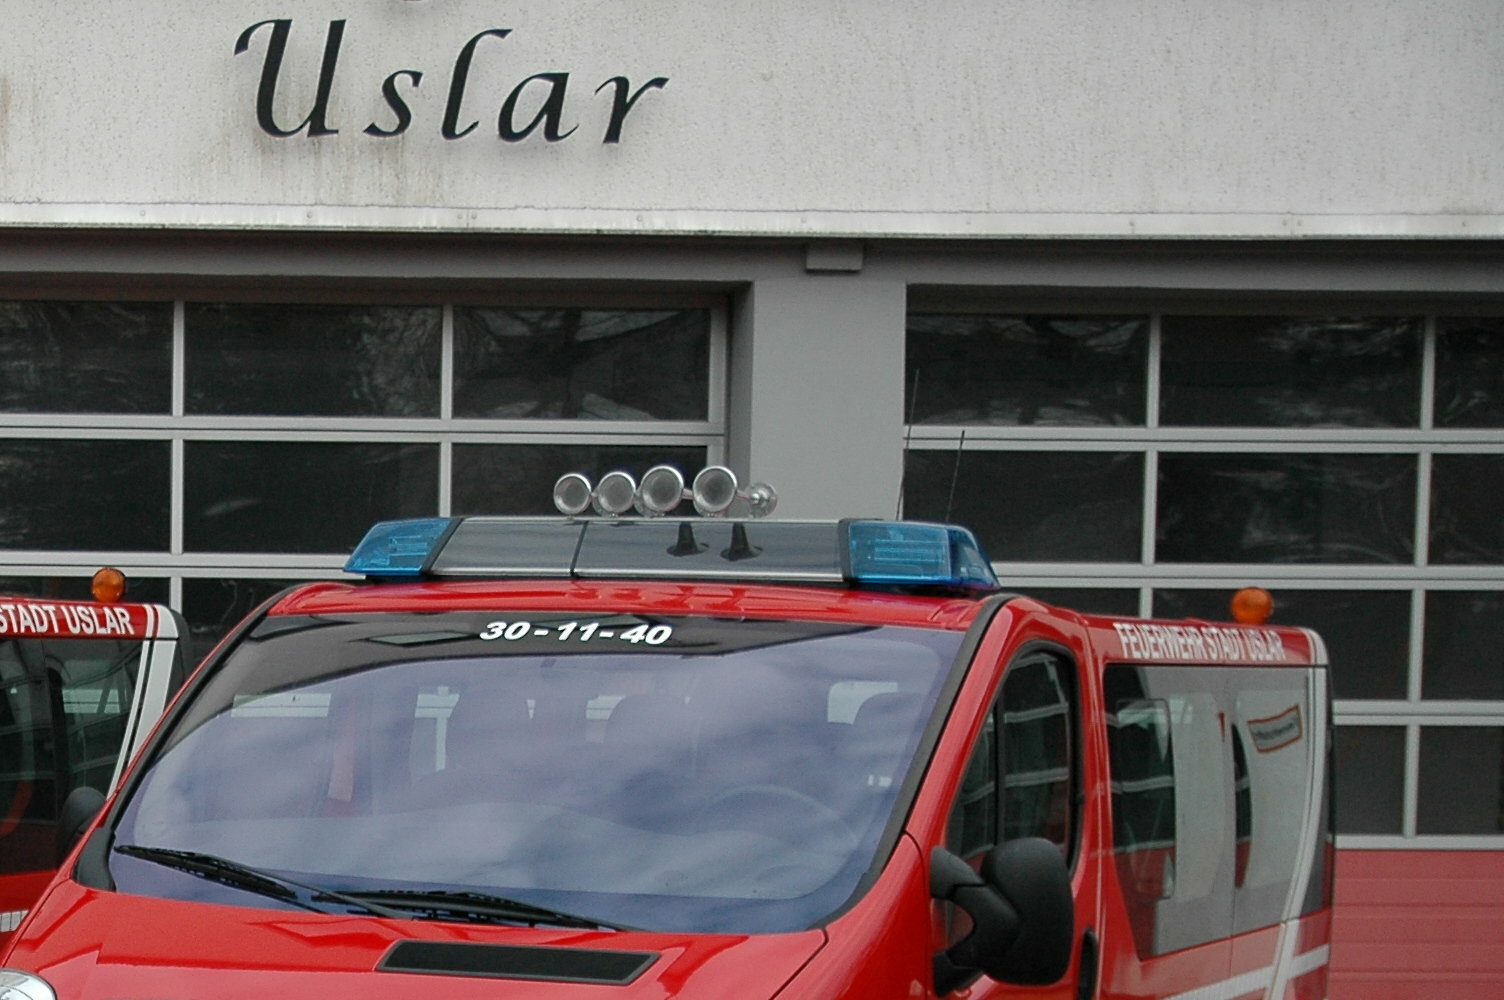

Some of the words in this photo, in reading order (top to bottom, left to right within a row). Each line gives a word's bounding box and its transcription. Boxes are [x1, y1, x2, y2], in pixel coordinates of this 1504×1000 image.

[234, 18, 670, 144] Uslar
[62, 604, 136, 636] USLAR
[1112, 622, 1209, 660] FEUERWEHR
